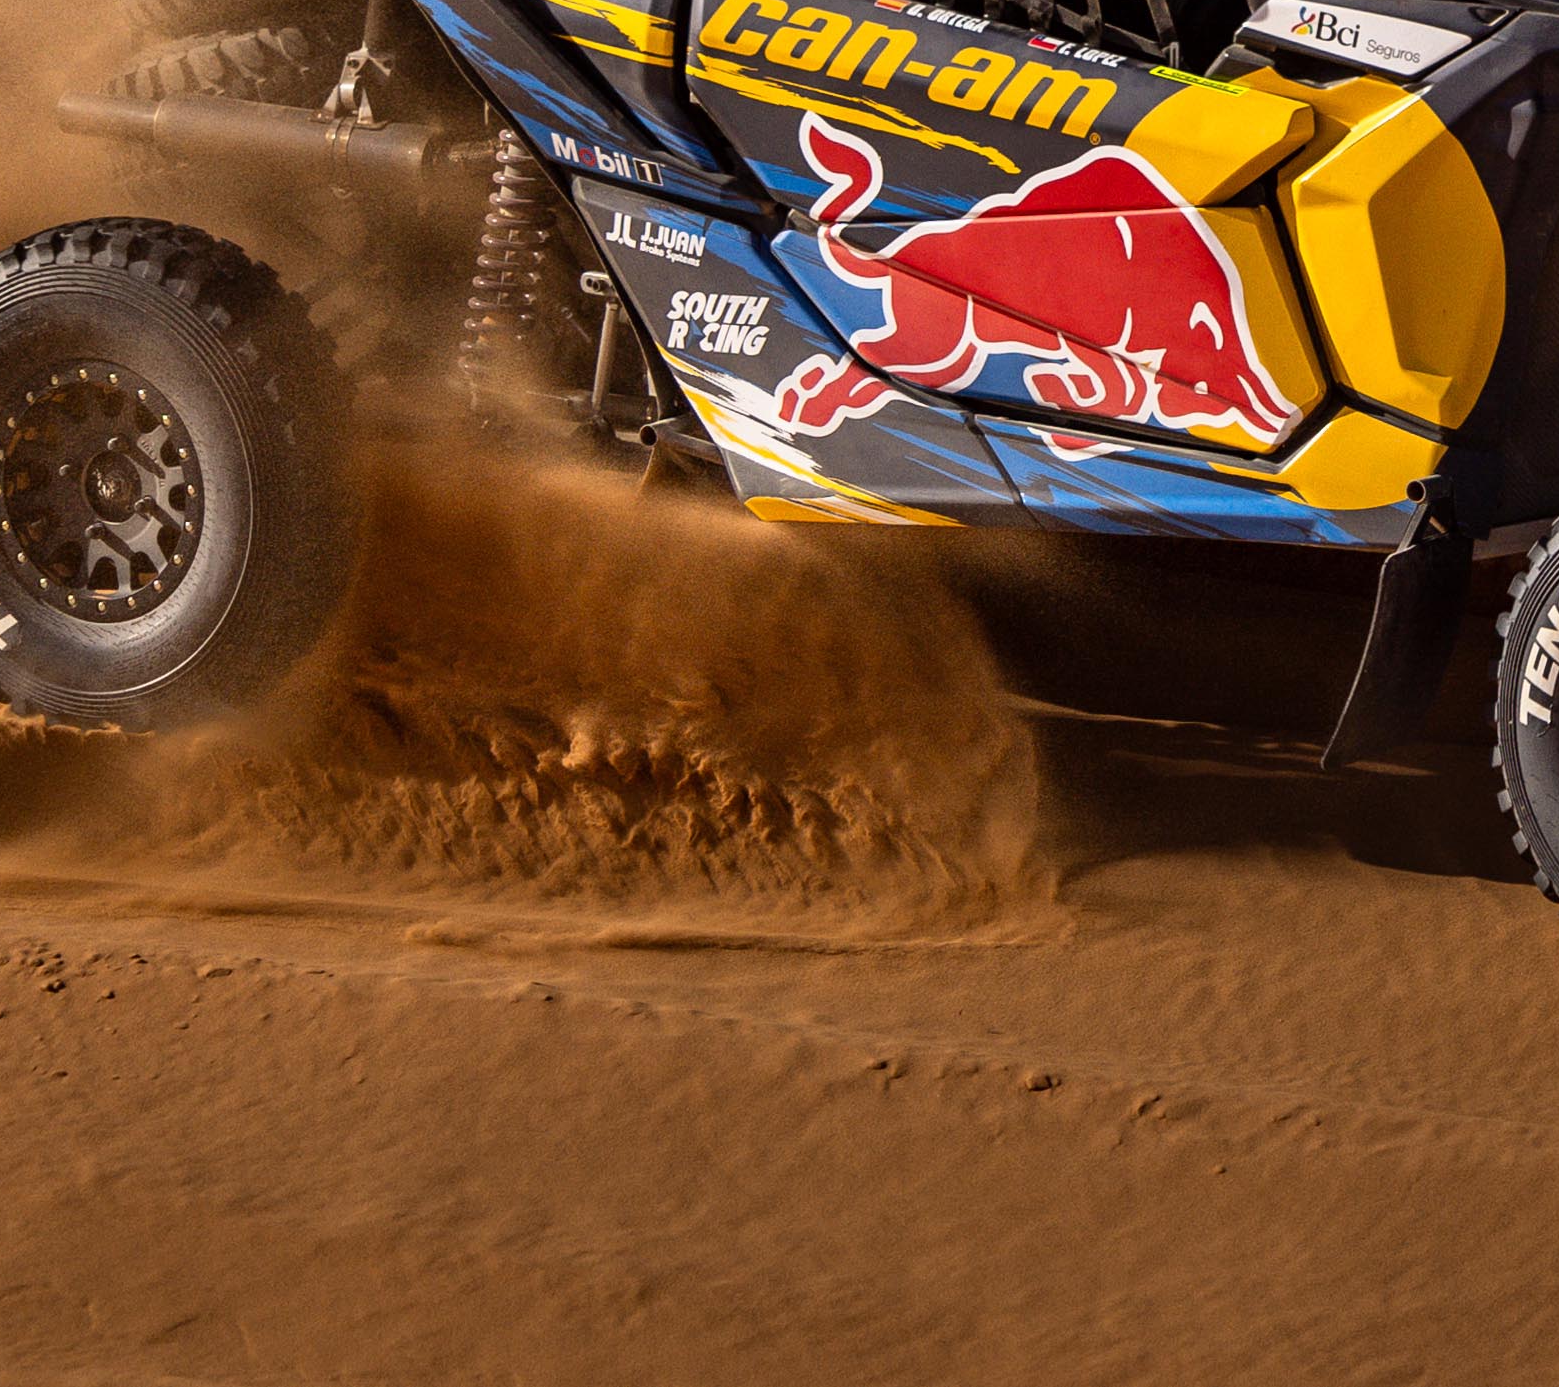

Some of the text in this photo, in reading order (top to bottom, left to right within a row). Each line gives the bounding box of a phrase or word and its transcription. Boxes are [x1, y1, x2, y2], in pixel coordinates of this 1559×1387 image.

[1315, 11, 1421, 64] Bci Seguros
[550, 132, 632, 179] Mobil
[666, 290, 770, 326] SOUTH
